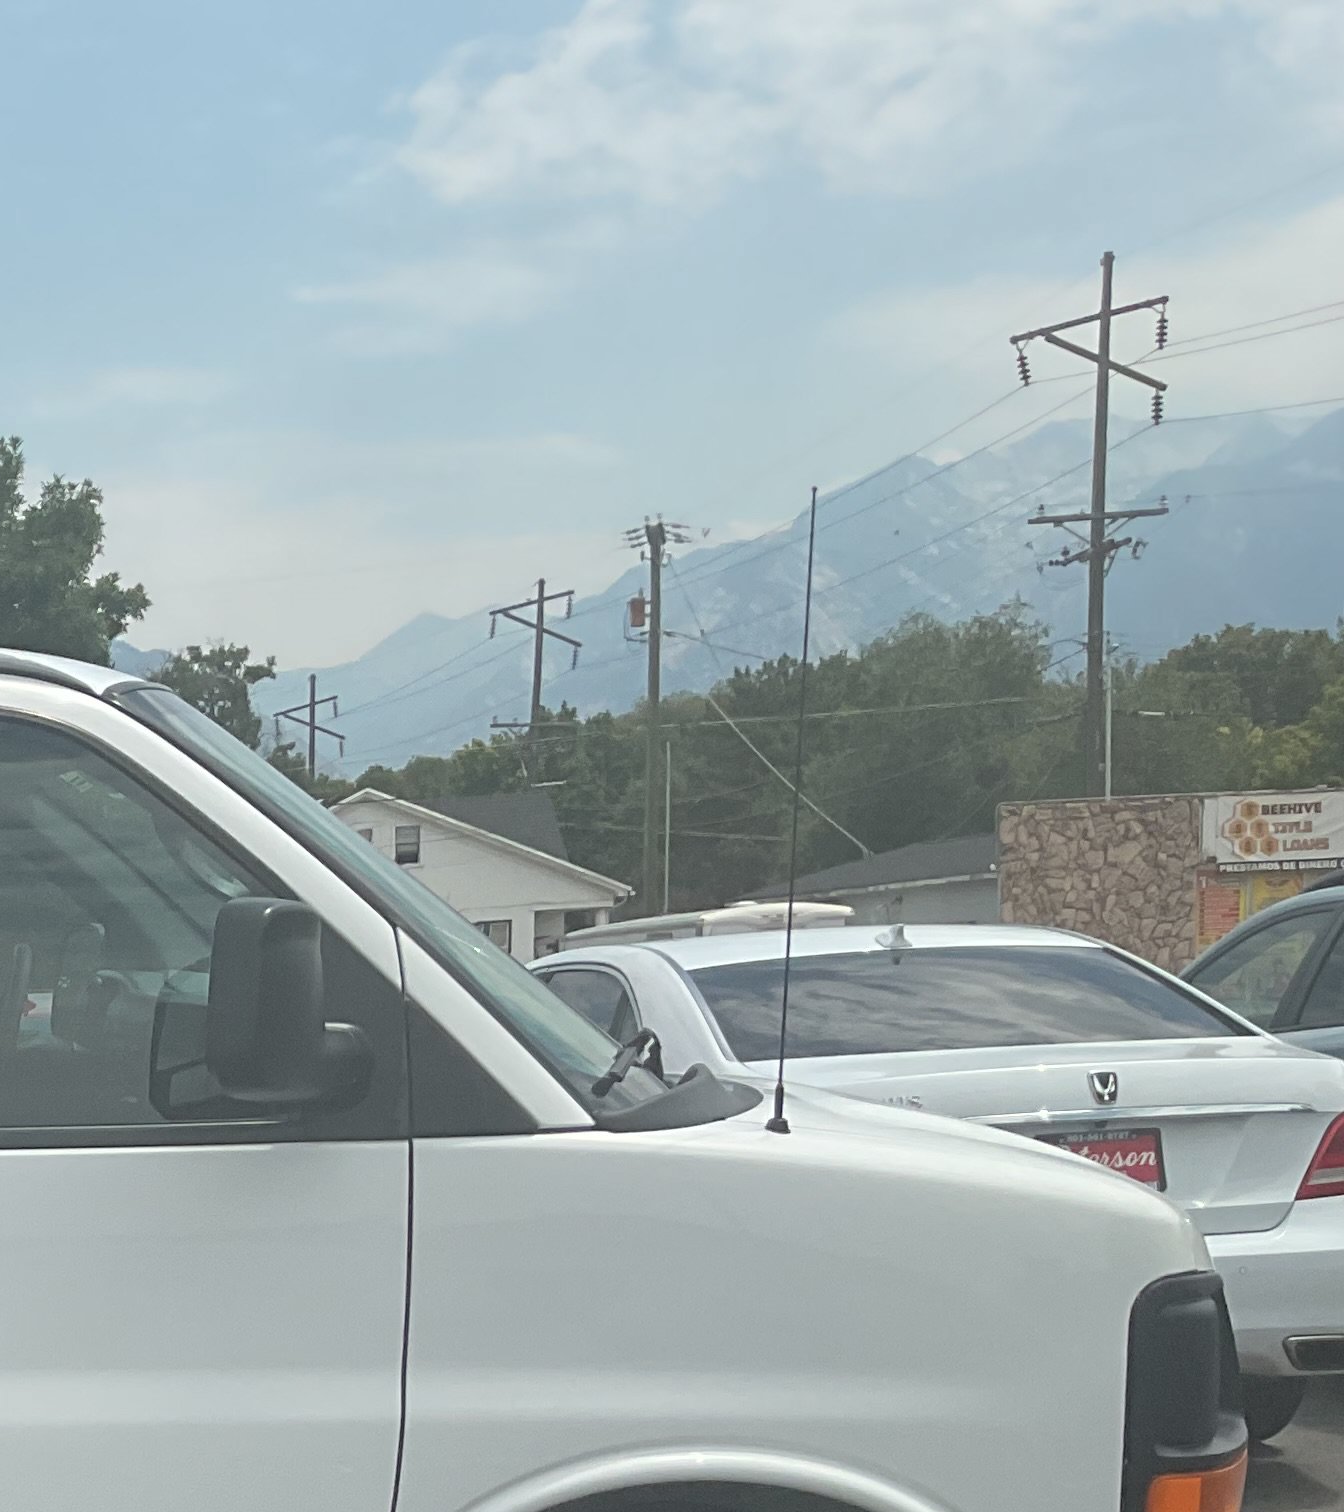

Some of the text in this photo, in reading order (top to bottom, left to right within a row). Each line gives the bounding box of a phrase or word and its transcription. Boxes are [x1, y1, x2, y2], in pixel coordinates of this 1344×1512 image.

[1261, 801, 1322, 815] BEEHIVE
[1272, 820, 1313, 833] TITLE
[1283, 837, 1329, 852] LOANS
